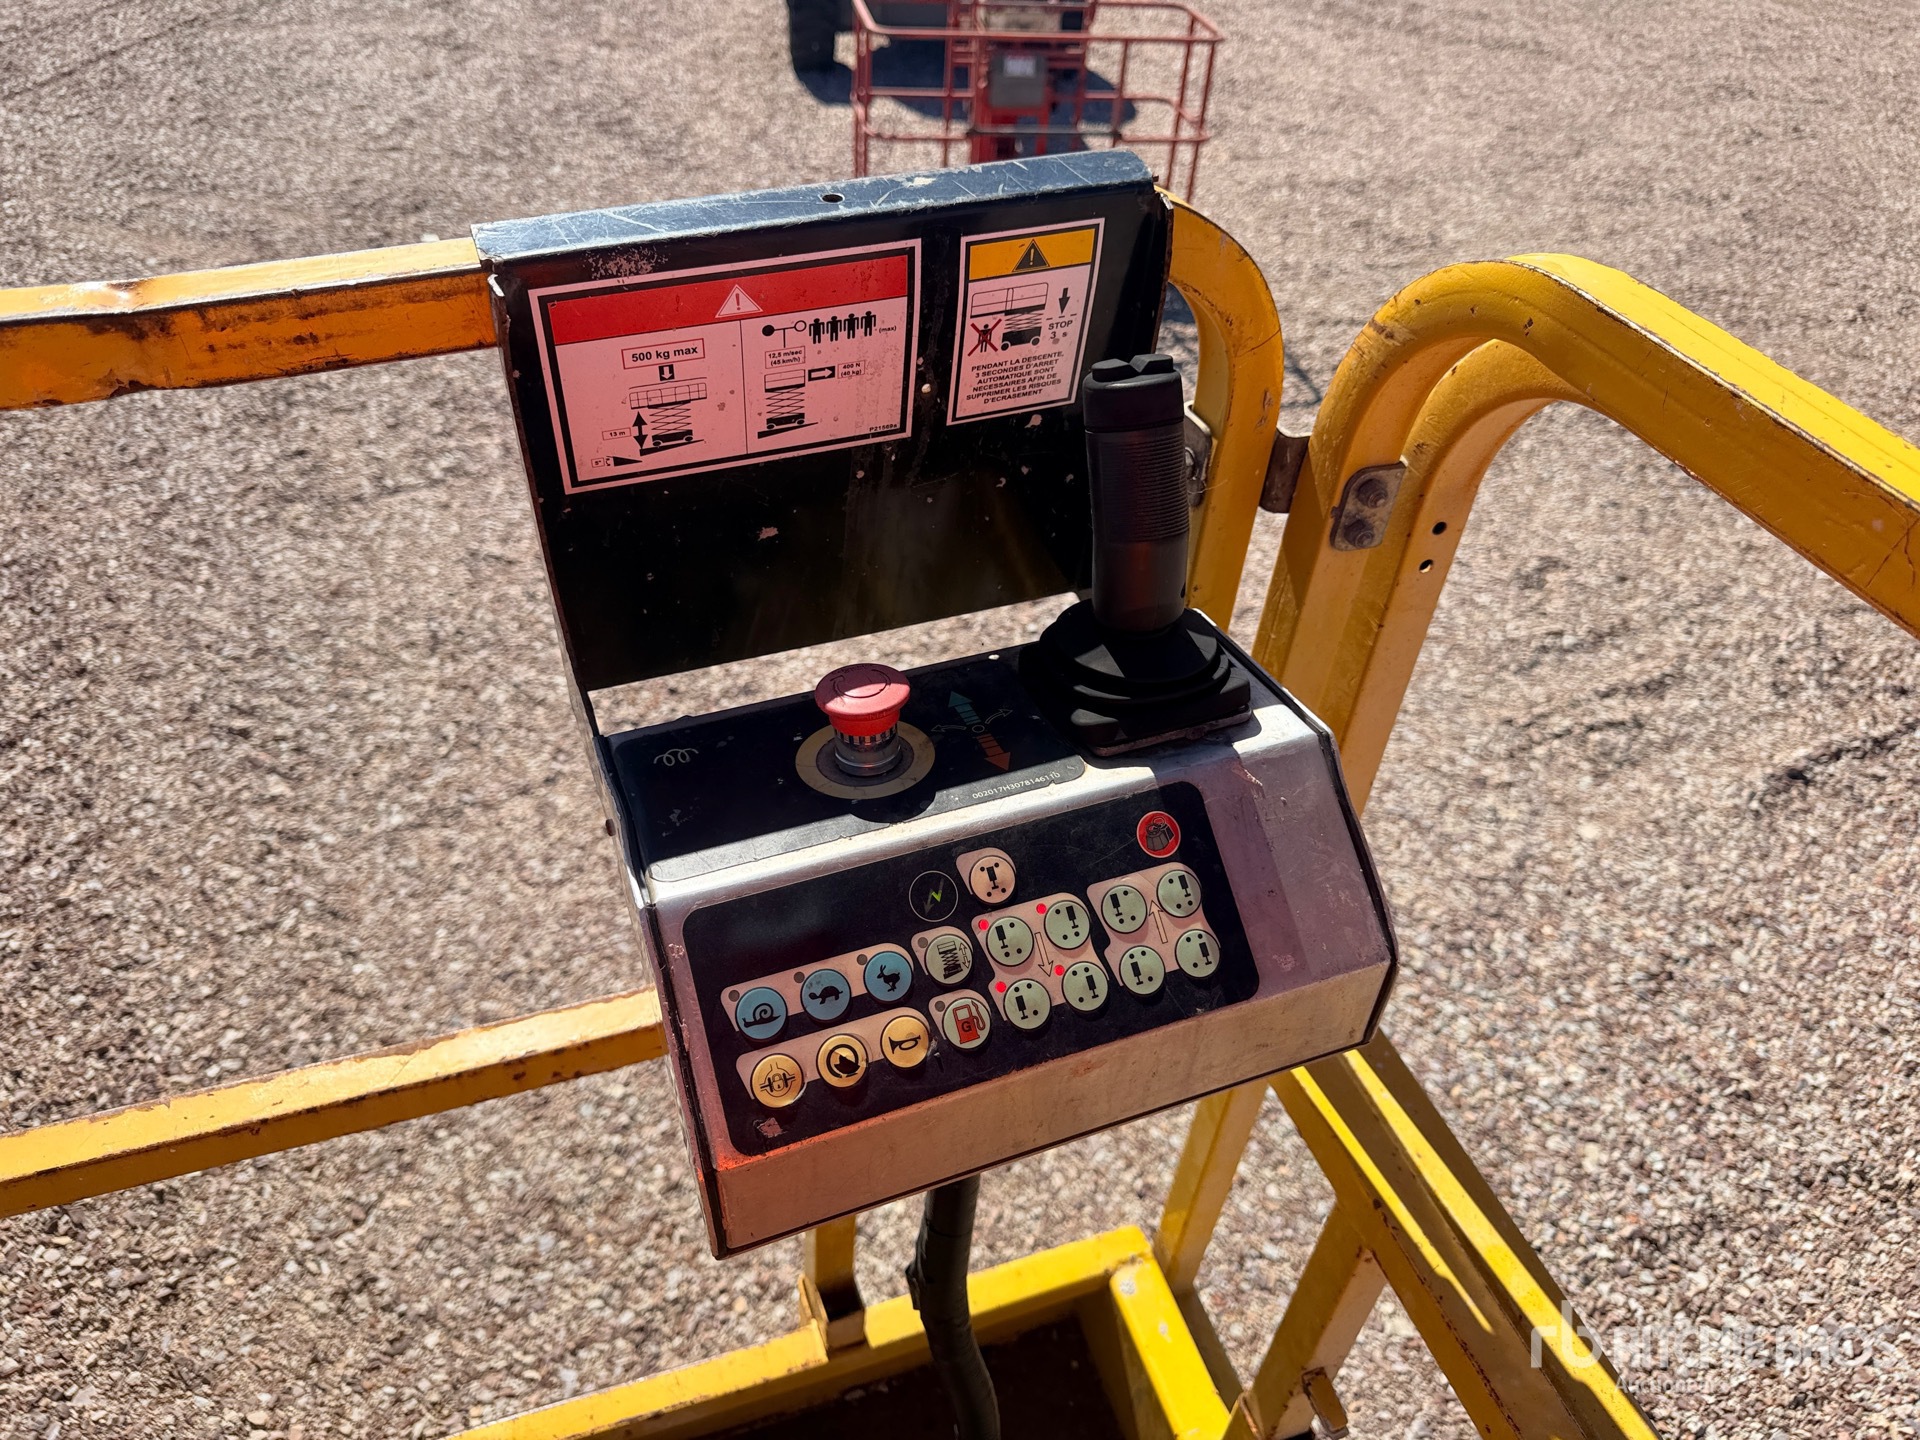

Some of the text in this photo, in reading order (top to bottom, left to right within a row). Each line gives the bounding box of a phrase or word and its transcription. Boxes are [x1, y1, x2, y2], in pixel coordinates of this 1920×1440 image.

[1048, 320, 1073, 330] STOP
[1050, 331, 1056, 339] 3
[631, 346, 698, 362] 500 kg max
[971, 360, 1008, 372] PENDANT
[1009, 358, 1020, 366] LA
[981, 365, 1024, 377] SECONDES
[1025, 358, 1059, 369] D'ARRET
[972, 372, 1058, 392] NECESSAIRES AFIN DE
[977, 366, 1055, 385] AUTOMATIQUE SONT
[966, 379, 1062, 401] SUPPRIMER LES RISQUES
[983, 388, 1043, 404] D'ECRASEMENT
[961, 1020, 972, 1032] G
